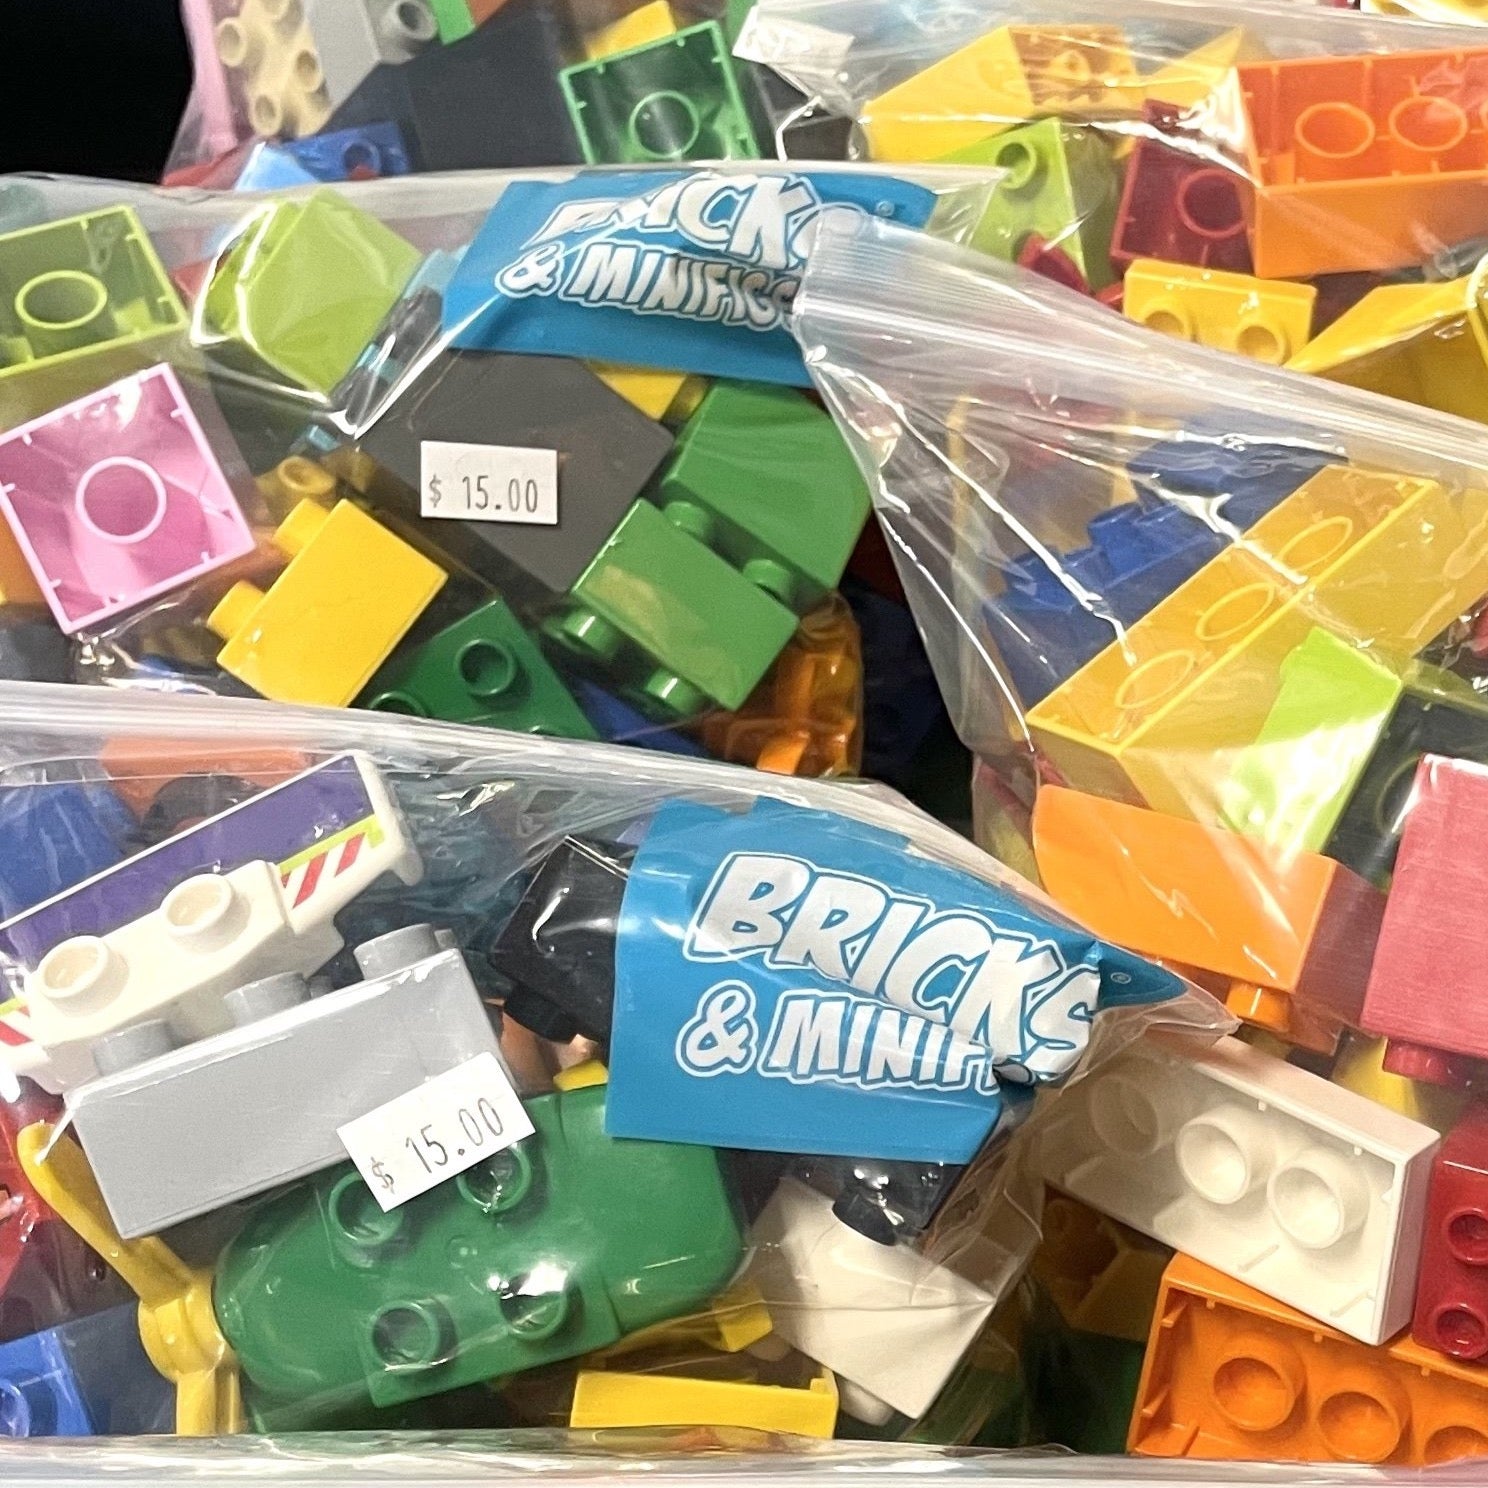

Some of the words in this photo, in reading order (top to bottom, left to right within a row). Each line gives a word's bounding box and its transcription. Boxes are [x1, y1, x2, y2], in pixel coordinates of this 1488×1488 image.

[495, 243, 564, 298] &
[428, 473, 443, 509] $
[461, 474, 539, 514] 15.00
[682, 851, 1101, 1083] BRICKS
[676, 979, 759, 1076] &
[757, 988, 1001, 1096] MINIF
[370, 1156, 396, 1195] $
[405, 1097, 504, 1174] 15.00
